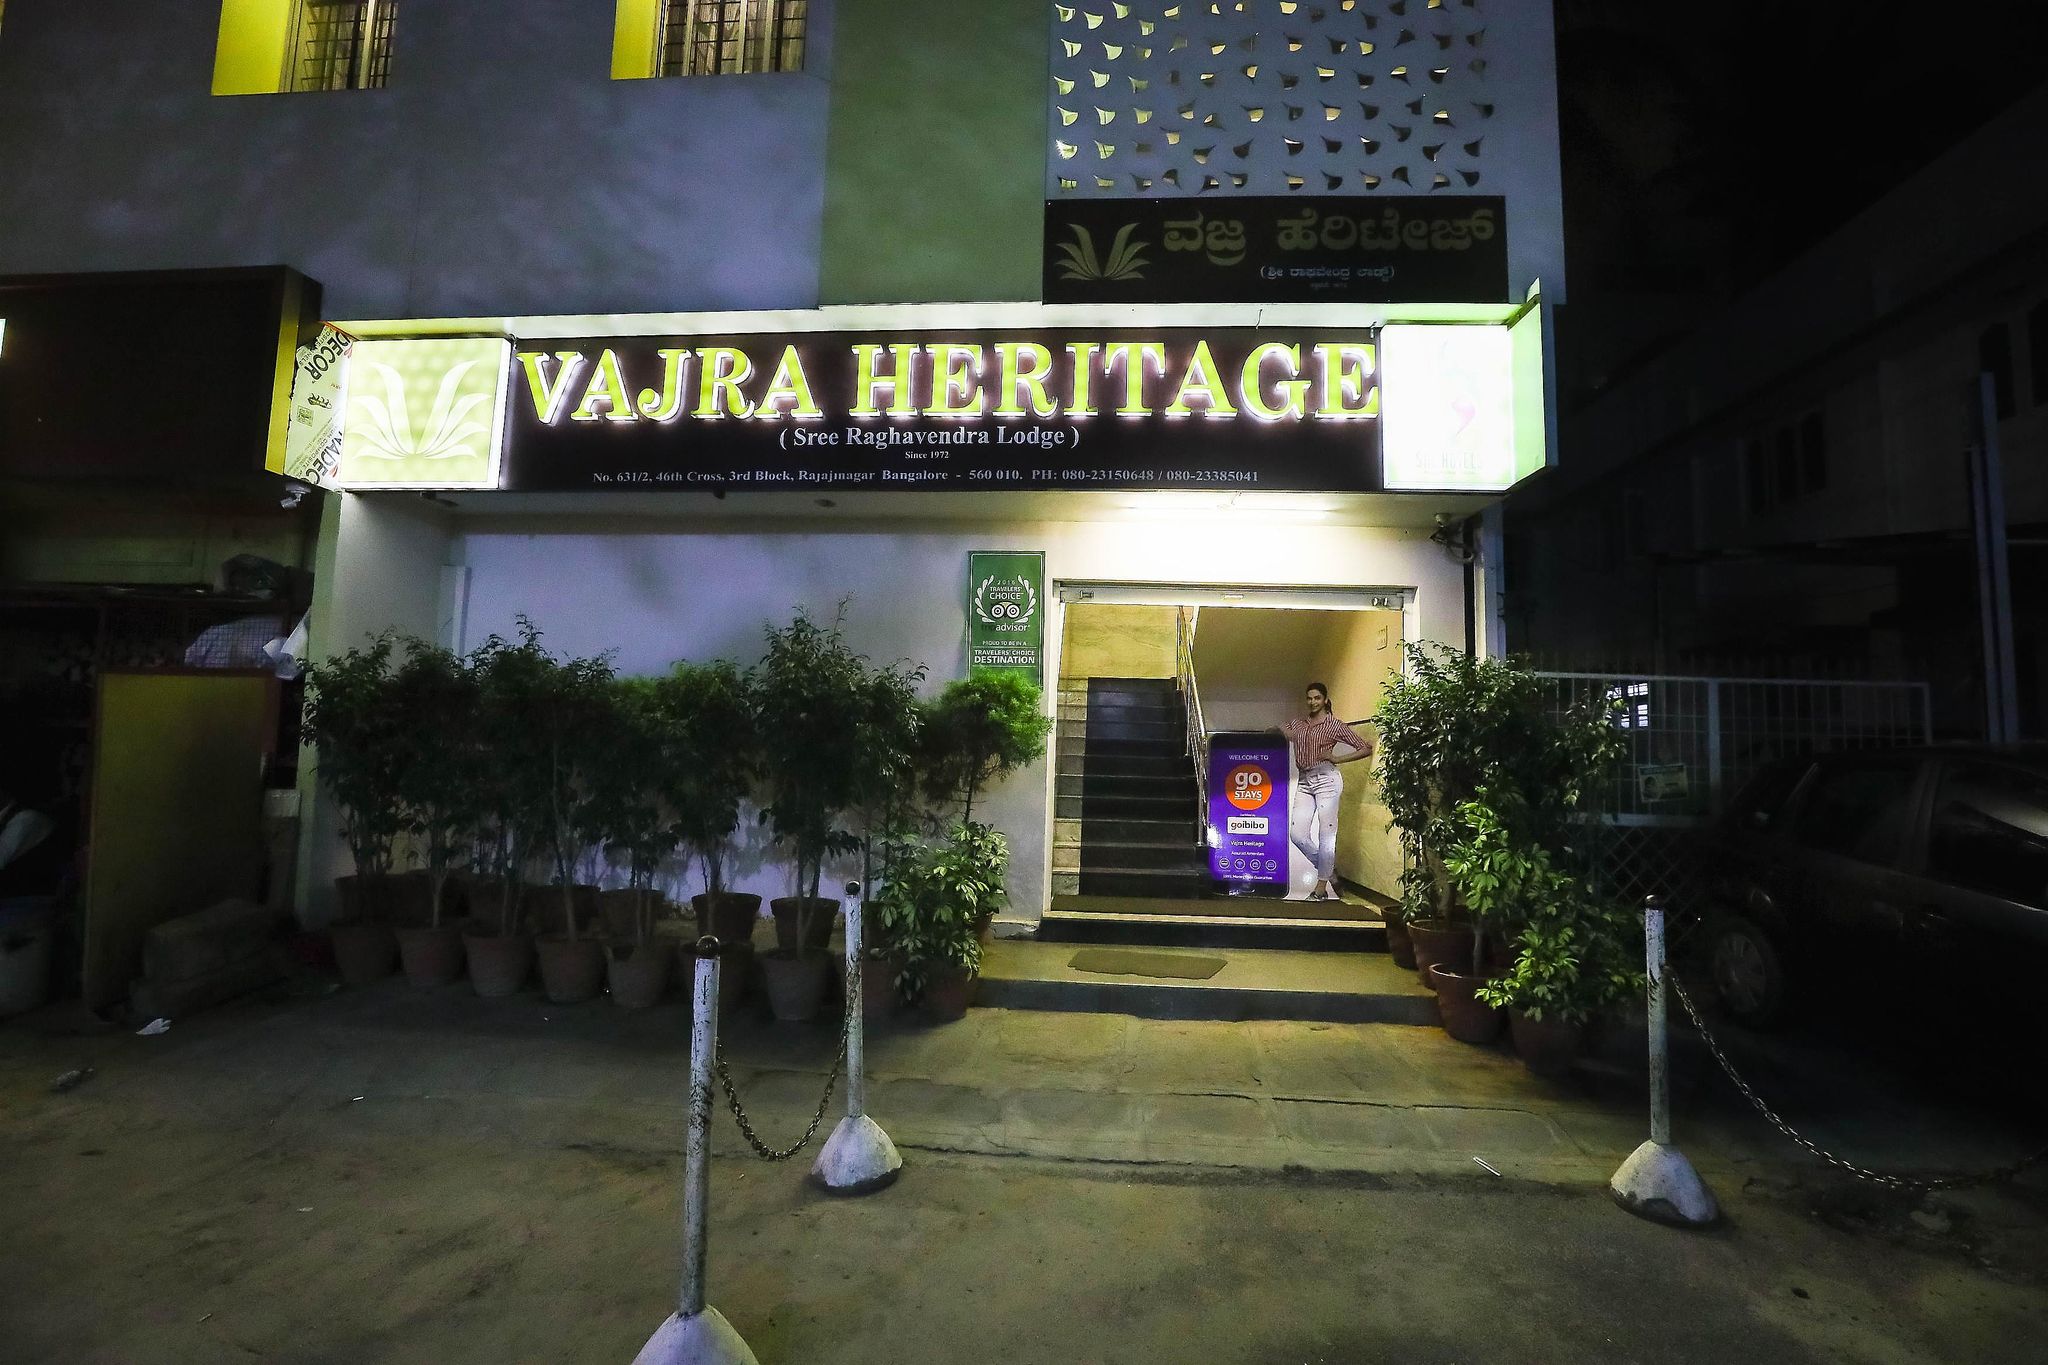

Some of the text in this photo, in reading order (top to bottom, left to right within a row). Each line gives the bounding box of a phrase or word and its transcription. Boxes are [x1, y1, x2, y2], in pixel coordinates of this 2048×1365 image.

[1163, 207, 1495, 267] ವಜ್ರ ಹೆರಿಟೇಜ್
[516, 341, 1380, 423] VAJRA HERITAGE
[793, 427, 839, 446] Sree
[845, 426, 990, 450] Raghavendra
[996, 426, 1065, 449] Lodge
[905, 451, 949, 459] Since 1972
[593, 472, 613, 482] No.
[617, 472, 652, 483] 631/2,
[655, 471, 683, 482] 46th
[729, 471, 751, 481] 3rd
[755, 470, 794, 483] Block,
[799, 470, 875, 482] Rajajinagar
[882, 470, 949, 483] Bangalore
[969, 469, 992, 480] 560
[996, 469, 1023, 480] 010.
[1032, 469, 1057, 480] PH:
[1062, 469, 1154, 481] 080-23150648
[1166, 470, 1258, 482] 080-23385041
[989, 592, 1021, 600] CHOICE
[974, 656, 1035, 664] DESTINATION
[1234, 772, 1262, 790] go
[1234, 790, 1263, 799] STAYS
[1230, 820, 1265, 831] goibibo
